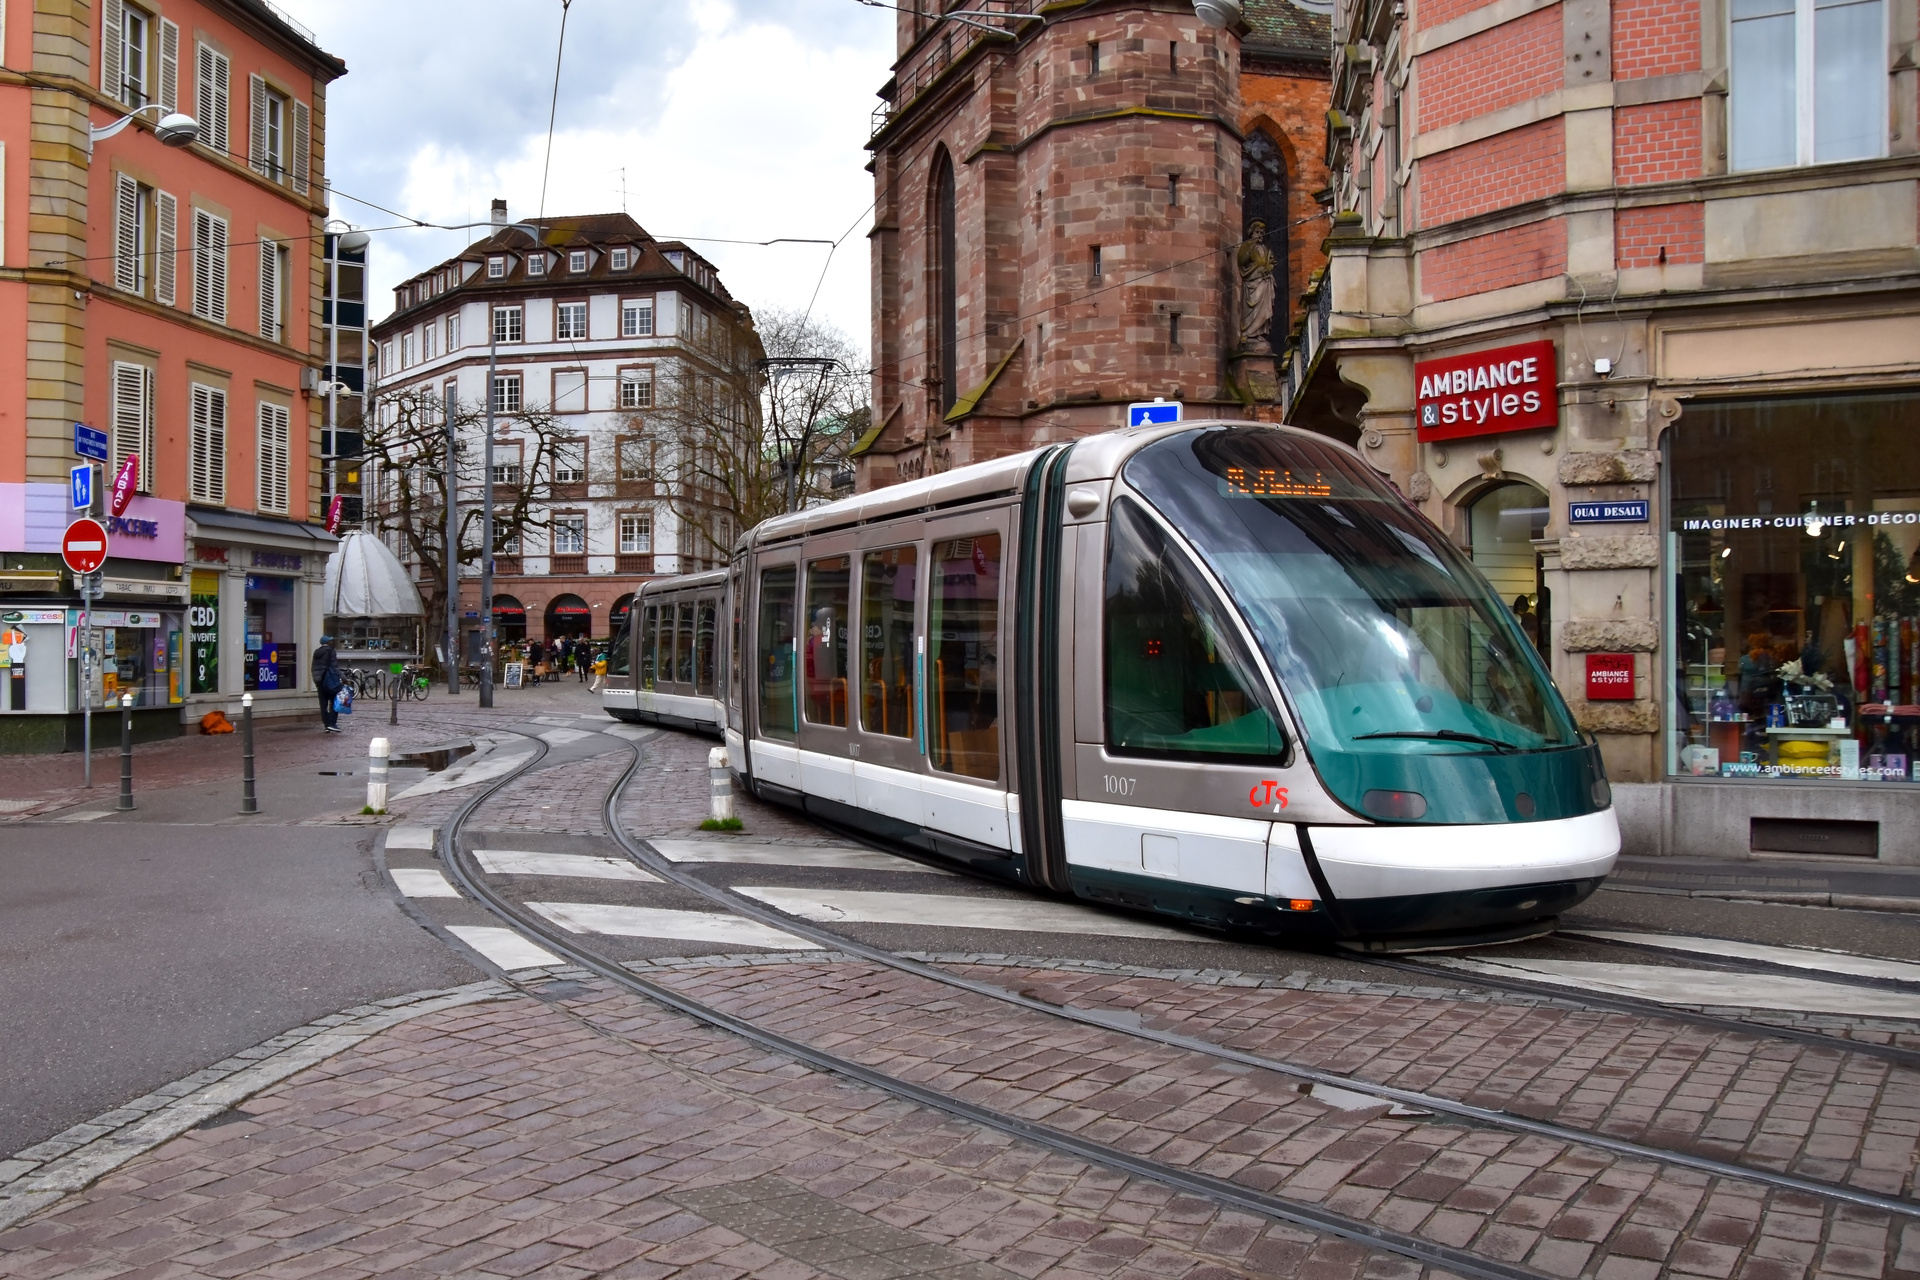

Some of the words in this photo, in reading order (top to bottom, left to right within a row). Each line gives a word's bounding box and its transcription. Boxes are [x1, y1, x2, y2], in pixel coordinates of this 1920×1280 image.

[1419, 357, 1539, 399] AMBIANCE
[1423, 405, 1436, 424] &
[1442, 391, 1541, 424] styles
[113, 462, 133, 508] TABAC
[329, 501, 342, 536] TABAC
[1574, 507, 1600, 518] QUAI
[1604, 505, 1643, 516] DESAIX
[1684, 517, 1763, 530] IMAGINER
[1773, 515, 1856, 528] CUISINER
[1867, 511, 1920, 525] DÉCO
[108, 516, 158, 537] EPICERIE
[116, 583, 132, 592] TABAC
[23, 613, 63, 622] express
[190, 606, 216, 627] CBD
[198, 633, 216, 642] VENTE
[1597, 677, 1629, 685] styles
[1103, 774, 1136, 796] 1007
